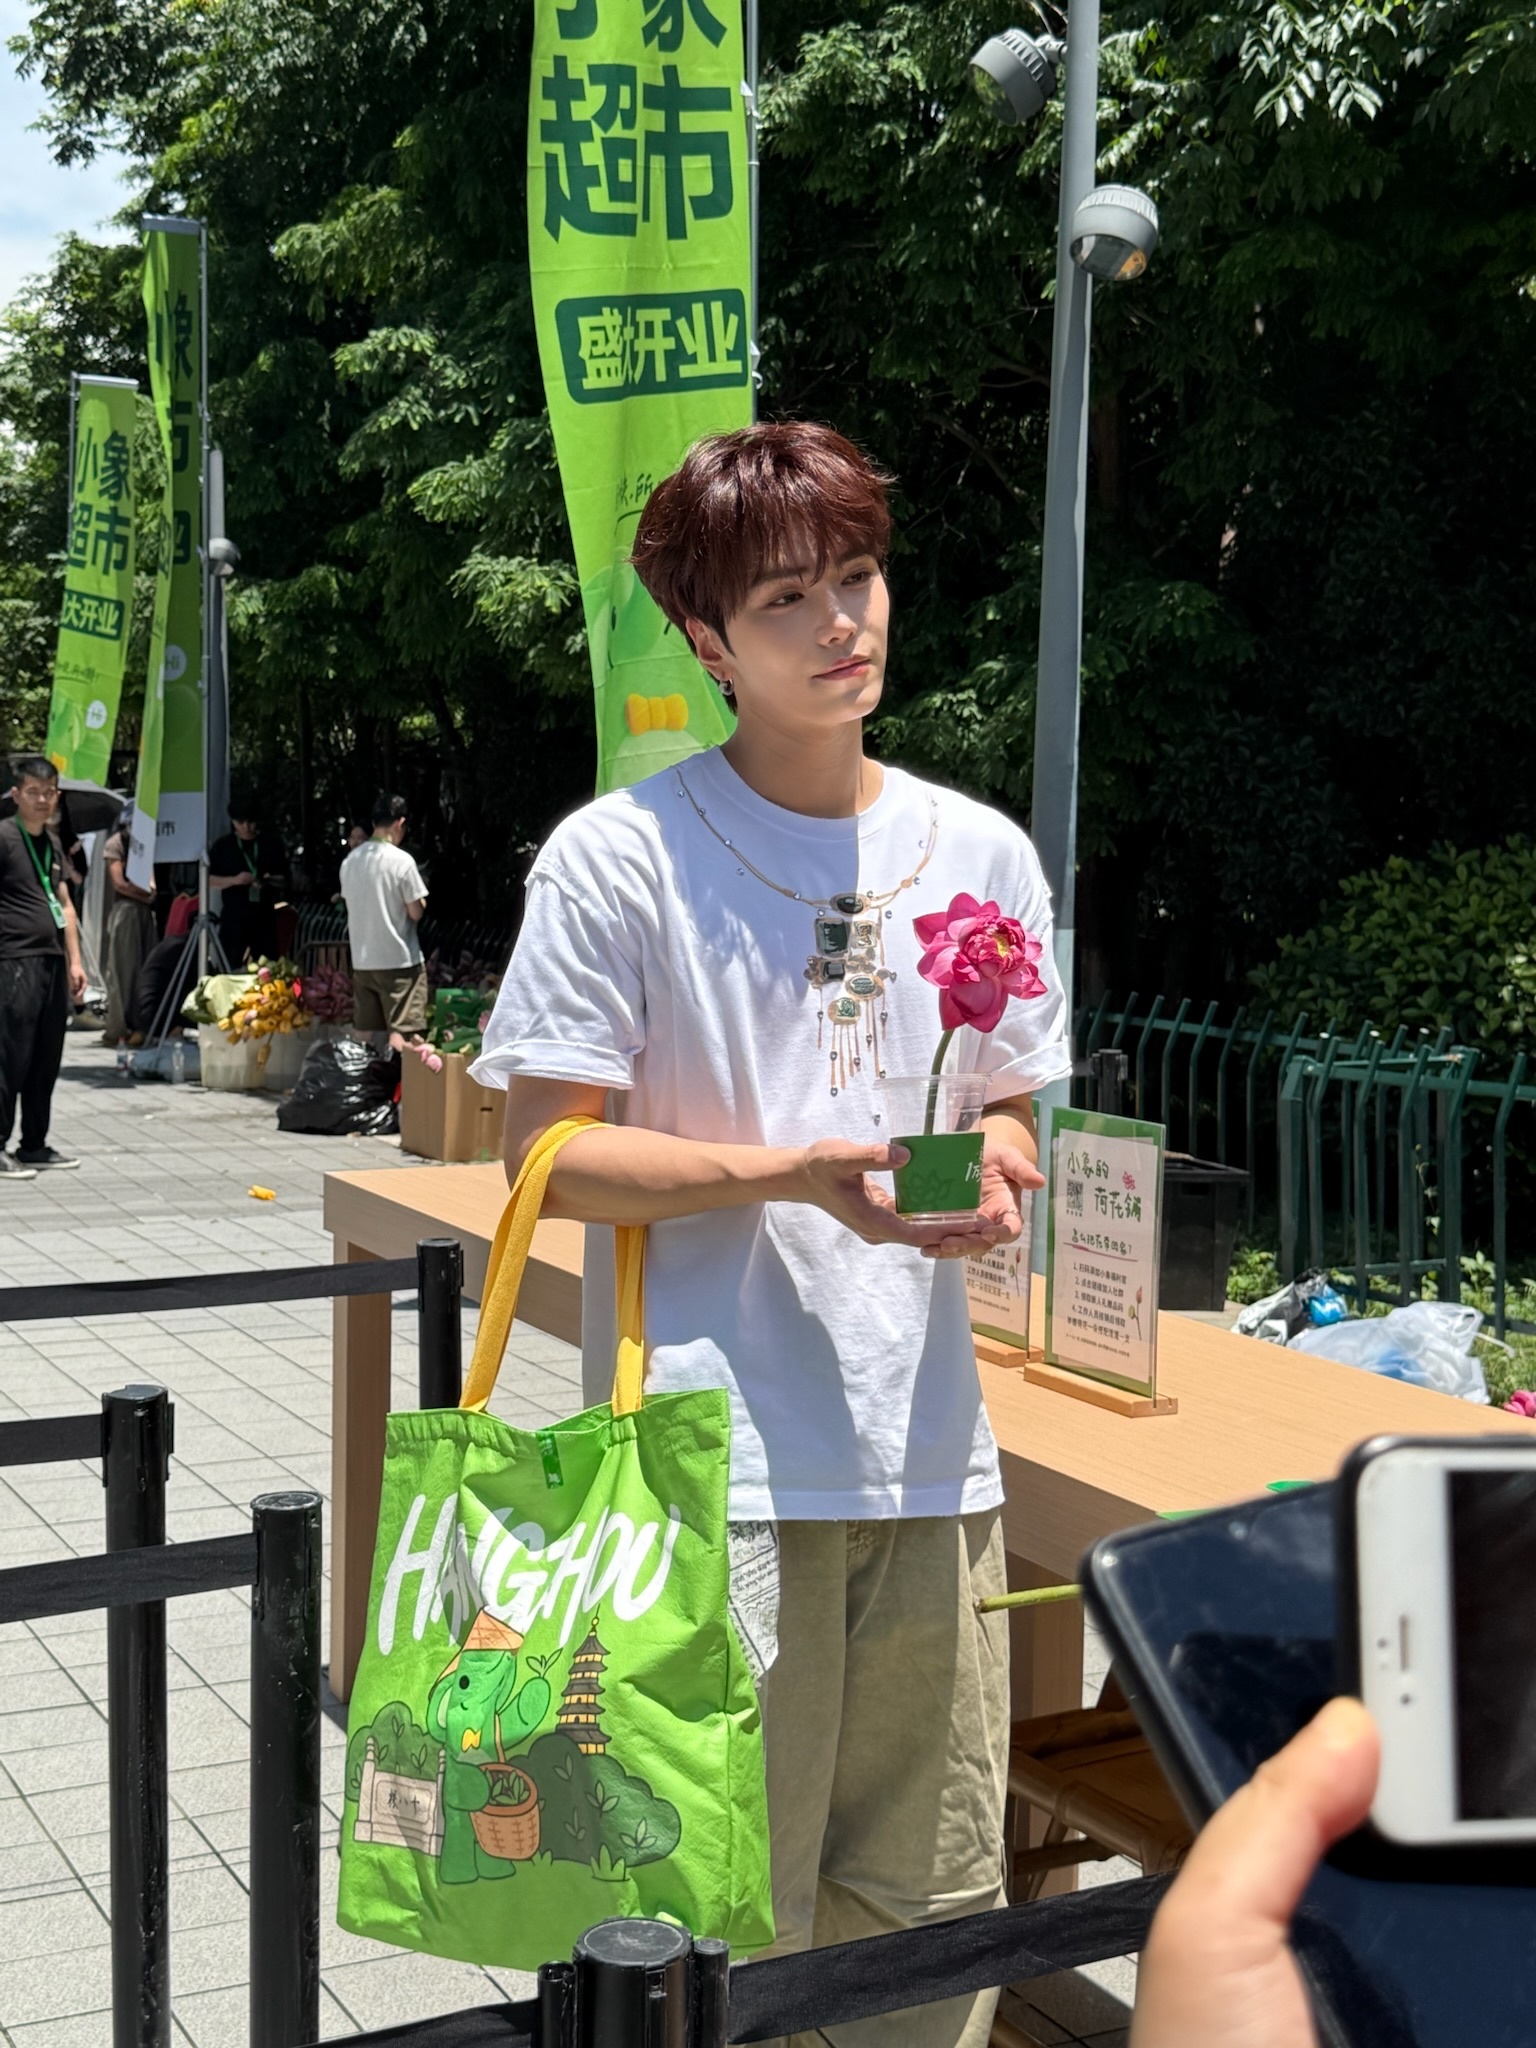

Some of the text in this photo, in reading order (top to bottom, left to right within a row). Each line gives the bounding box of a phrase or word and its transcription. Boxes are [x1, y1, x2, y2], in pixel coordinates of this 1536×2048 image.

[540, 55, 734, 242] 超市
[75, 427, 131, 502] 小象
[61, 591, 120, 636] 大开业
[1067, 1151, 1109, 1180] 小象的
[1094, 1186, 1142, 1223] 荷花铺
